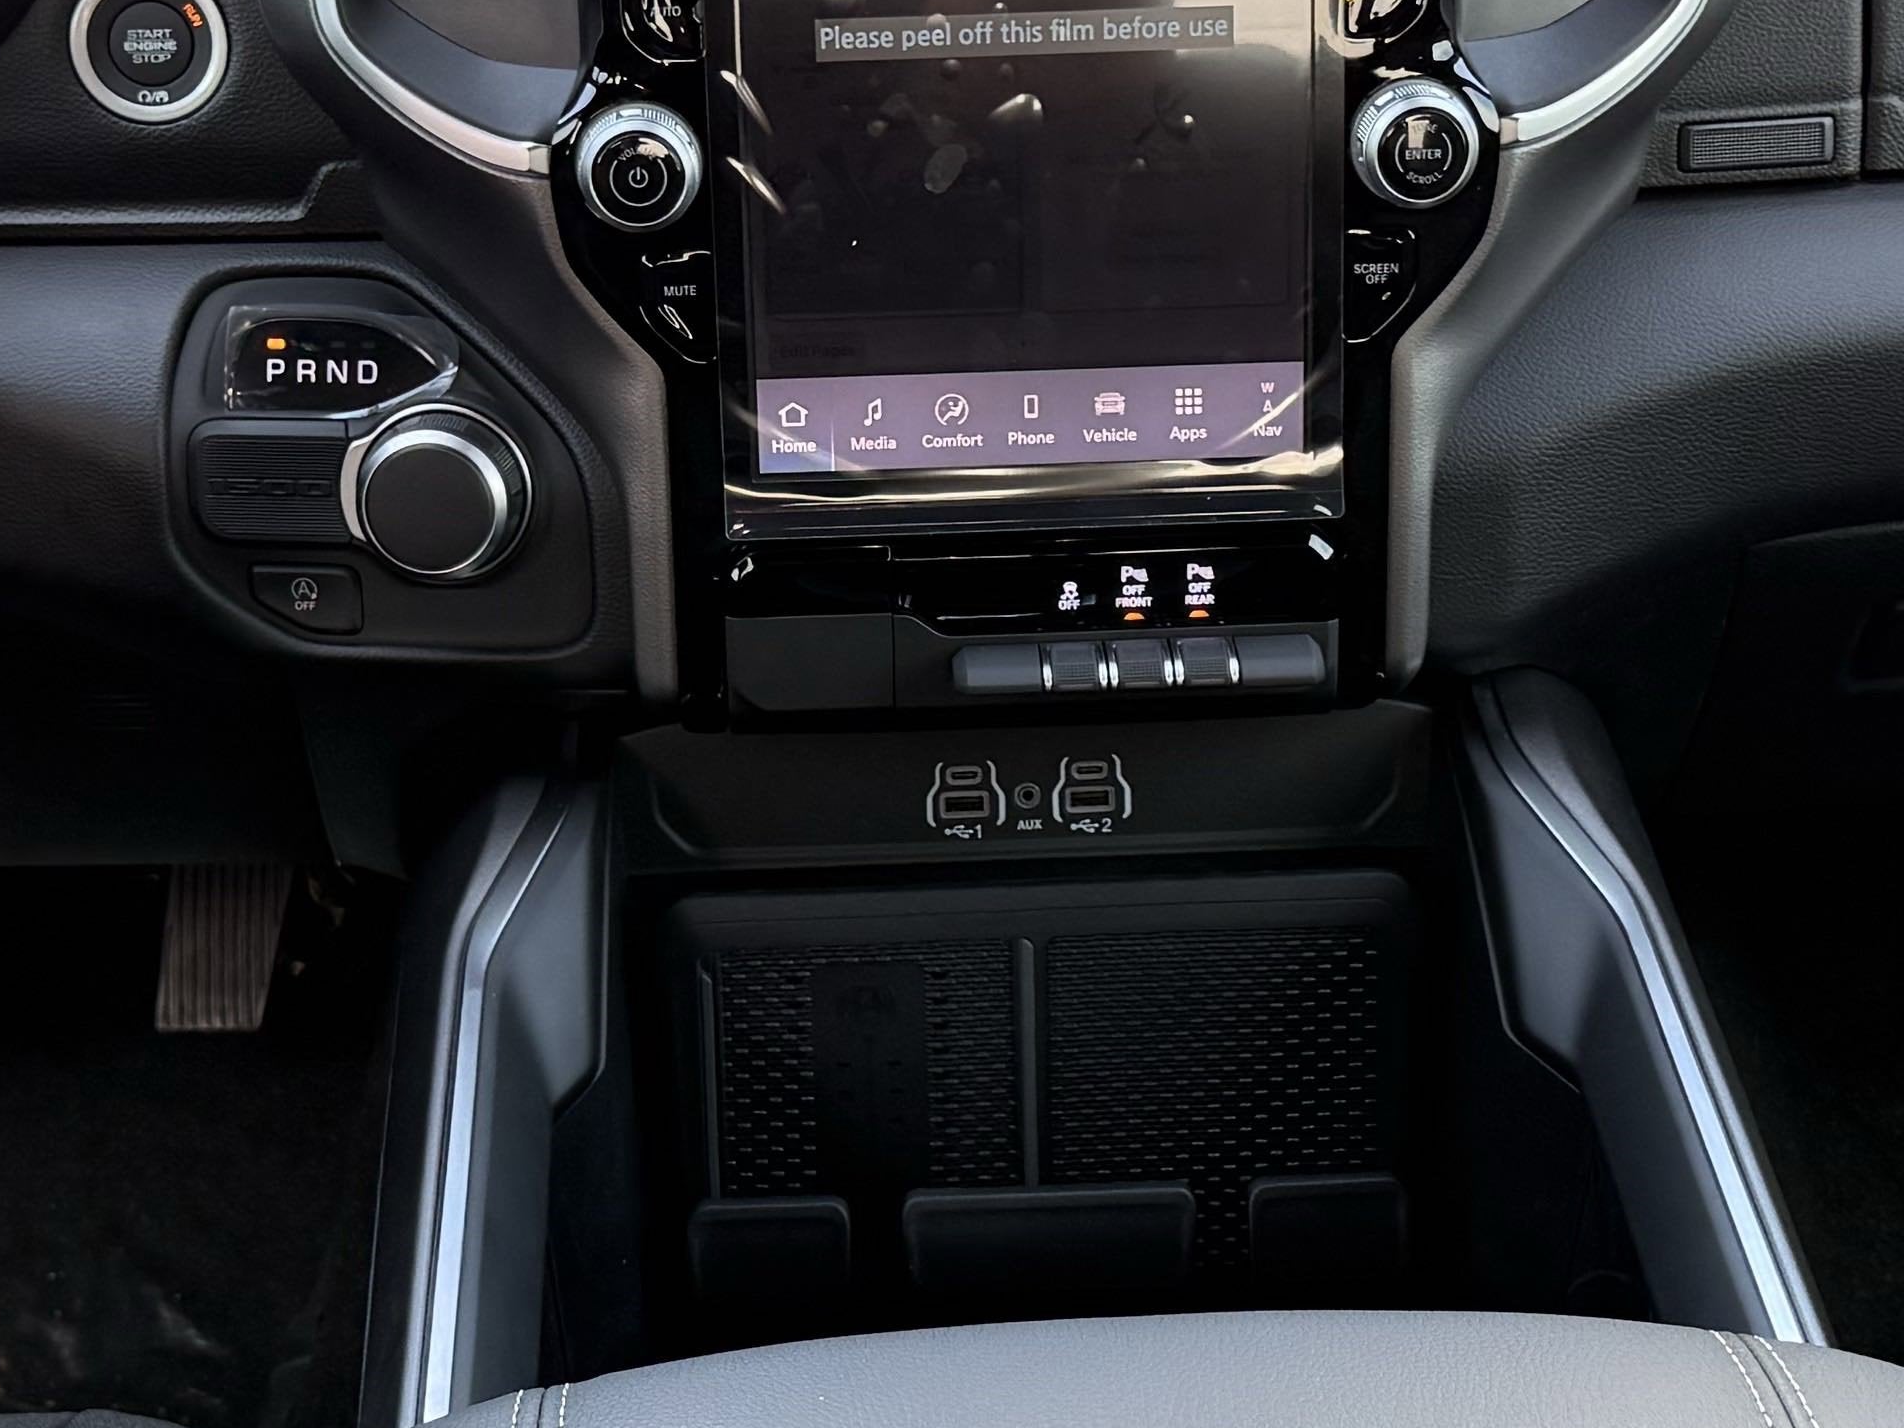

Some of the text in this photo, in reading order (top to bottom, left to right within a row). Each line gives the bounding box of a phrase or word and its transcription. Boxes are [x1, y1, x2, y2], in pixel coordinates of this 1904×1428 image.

[127, 28, 172, 40] START
[819, 15, 1228, 52] Please peel off this film before use
[132, 53, 172, 64] STOP
[1405, 148, 1442, 160] ENTER
[1405, 171, 1443, 185] SCROLL
[1353, 262, 1400, 274] SCREEN
[1365, 274, 1388, 285] OFF
[663, 285, 697, 297] MUTE
[1082, 428, 1138, 443] Vehicle
[1169, 425, 1208, 443] Apps
[1253, 424, 1283, 438] Nav
[850, 435, 897, 451] Media
[922, 433, 984, 449] Comfort
[1007, 431, 1056, 445] Phone
[771, 439, 817, 453] Home
[1122, 584, 1146, 596] OFF
[1188, 582, 1211, 593] OFF
[294, 600, 316, 611] OFF
[1058, 599, 1081, 611] OFF
[1115, 596, 1153, 608] FRONT
[1184, 594, 1215, 605] REAR
[1017, 819, 1043, 830] AUX
[1101, 818, 1113, 833] 2
